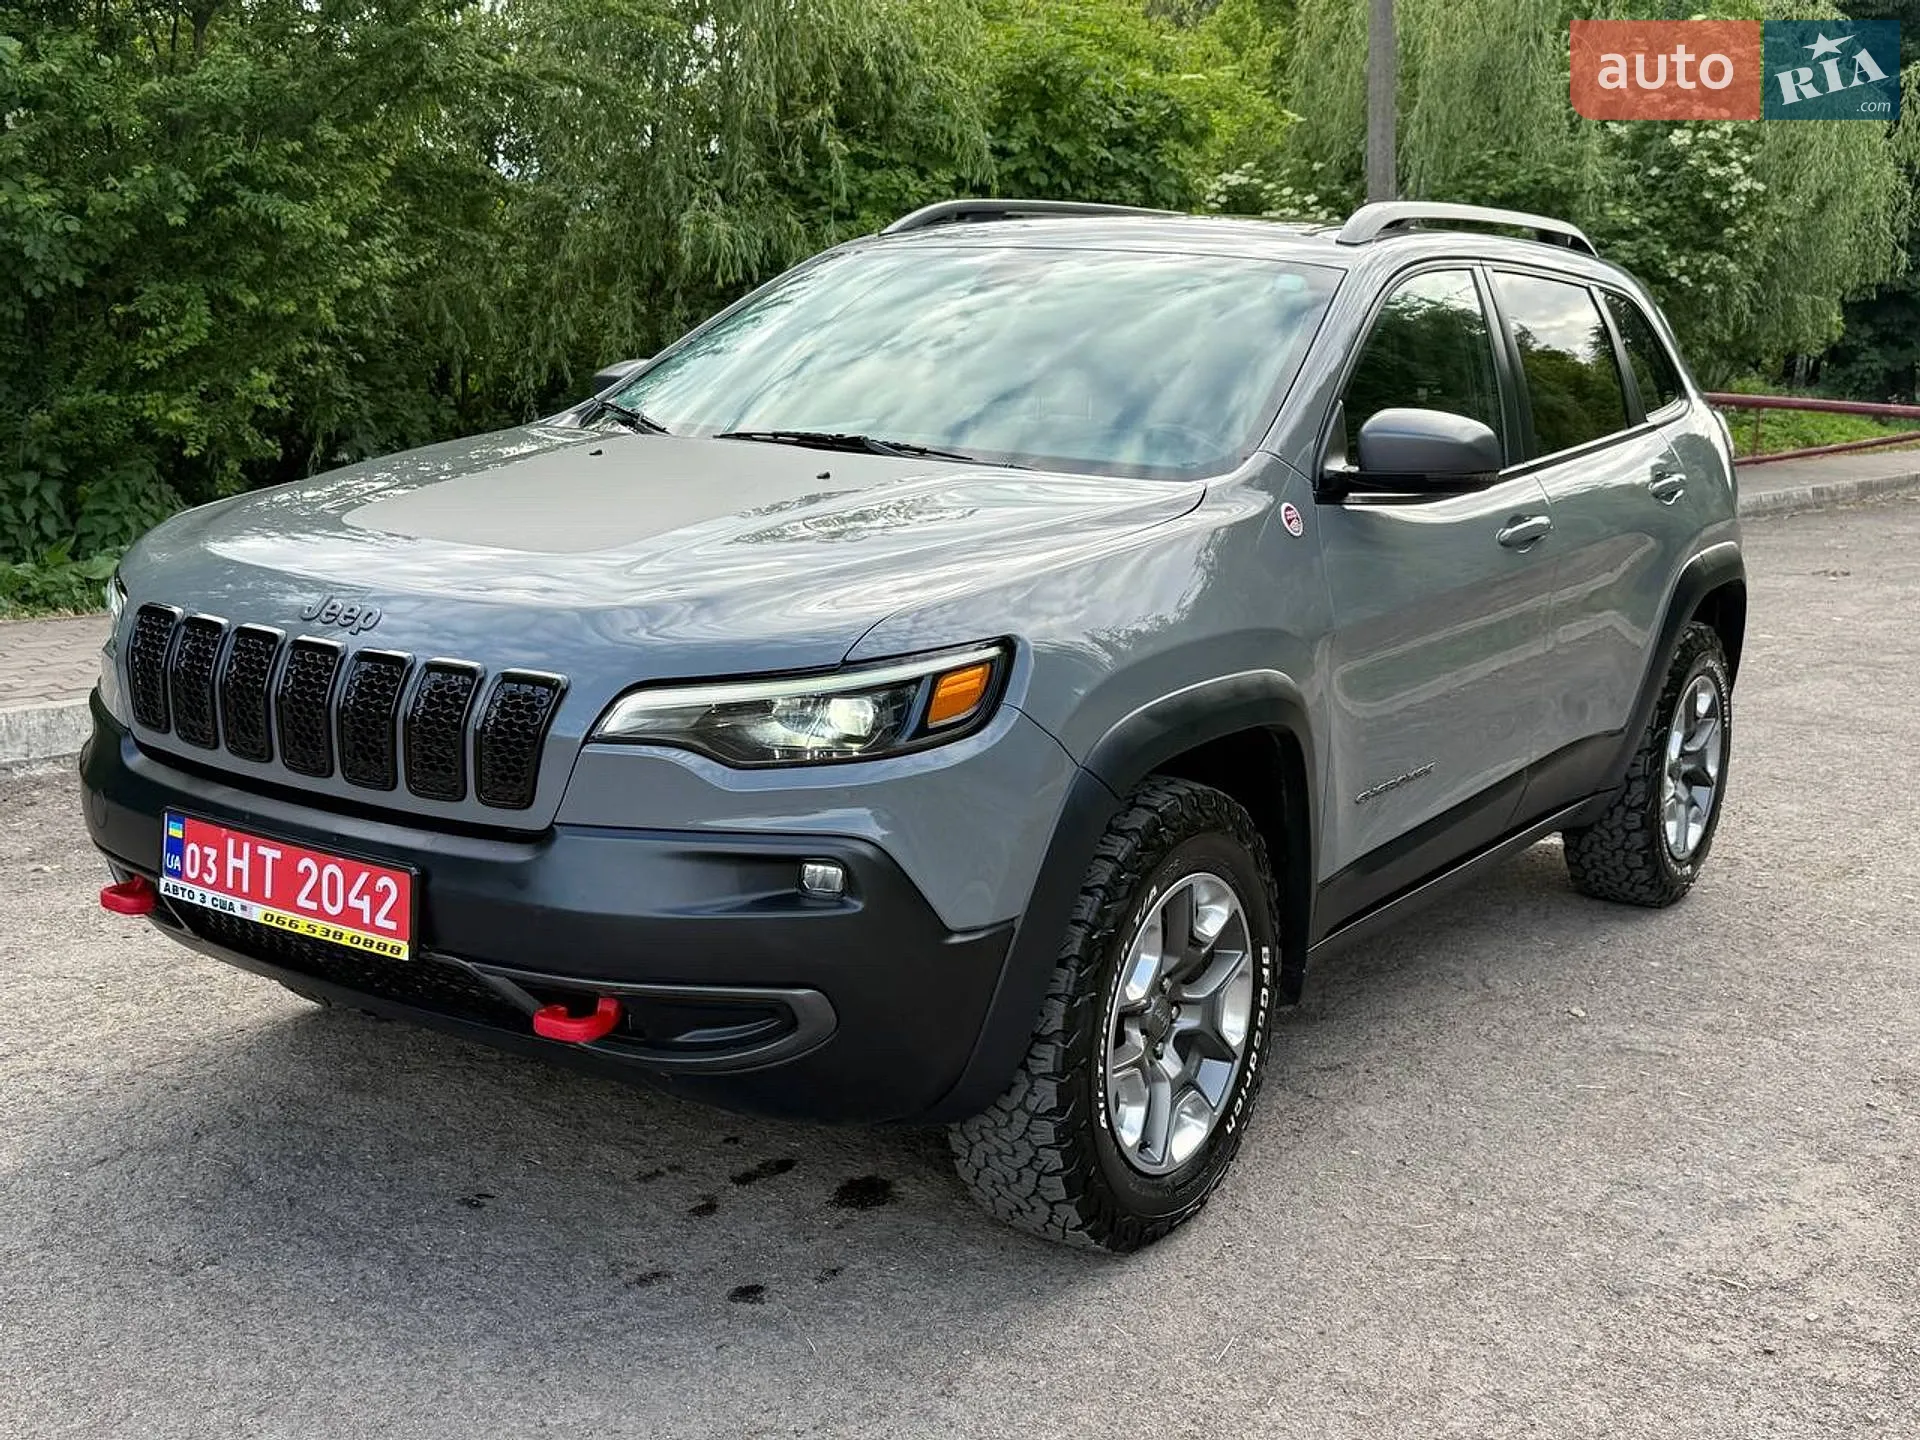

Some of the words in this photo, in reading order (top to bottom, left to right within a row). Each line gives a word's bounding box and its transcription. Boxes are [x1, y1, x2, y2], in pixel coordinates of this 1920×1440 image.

[300, 594, 382, 635] Jeep
[166, 852, 182, 872] UA
[163, 882, 195, 900] АВТО
[211, 896, 236, 913] США
[296, 857, 398, 931] 2042
